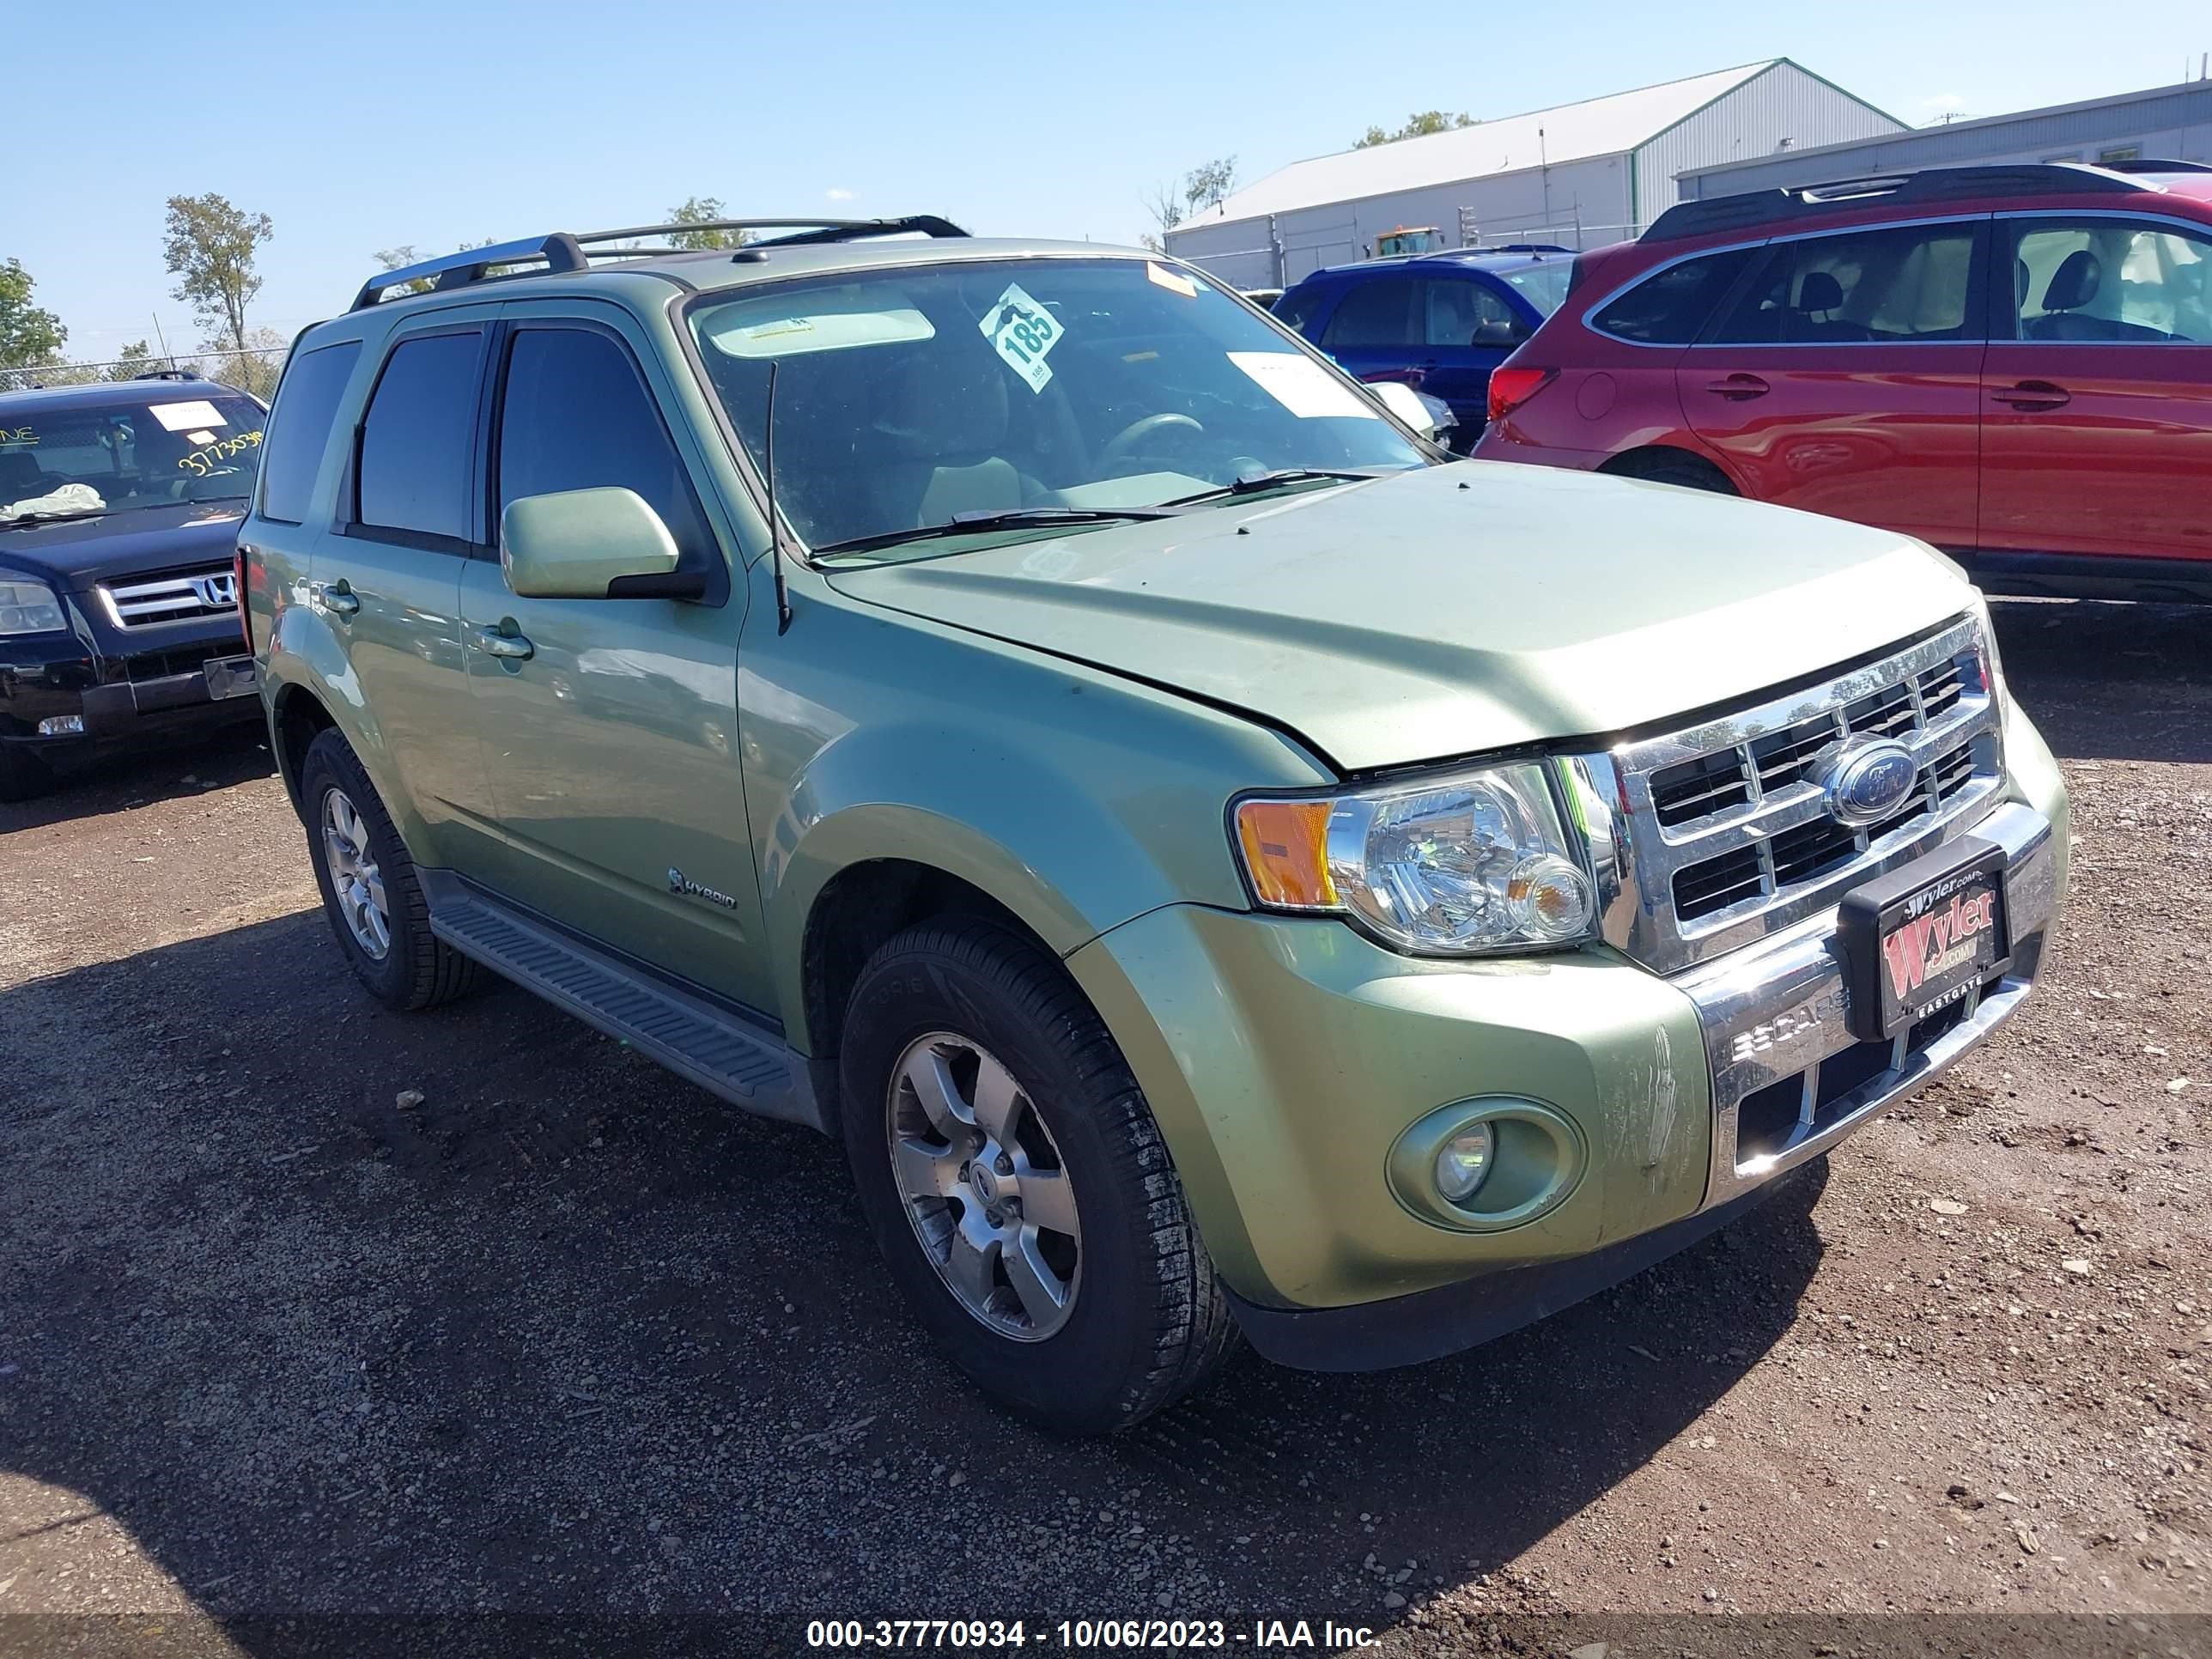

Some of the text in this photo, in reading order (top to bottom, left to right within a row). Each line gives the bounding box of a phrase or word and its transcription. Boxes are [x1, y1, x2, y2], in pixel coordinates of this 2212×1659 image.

[1005, 317, 1053, 365] 185
[1869, 763, 1904, 802] Ford
[1883, 890, 1996, 1000] Wyler
[1918, 975, 1983, 1018] EASTGATE
